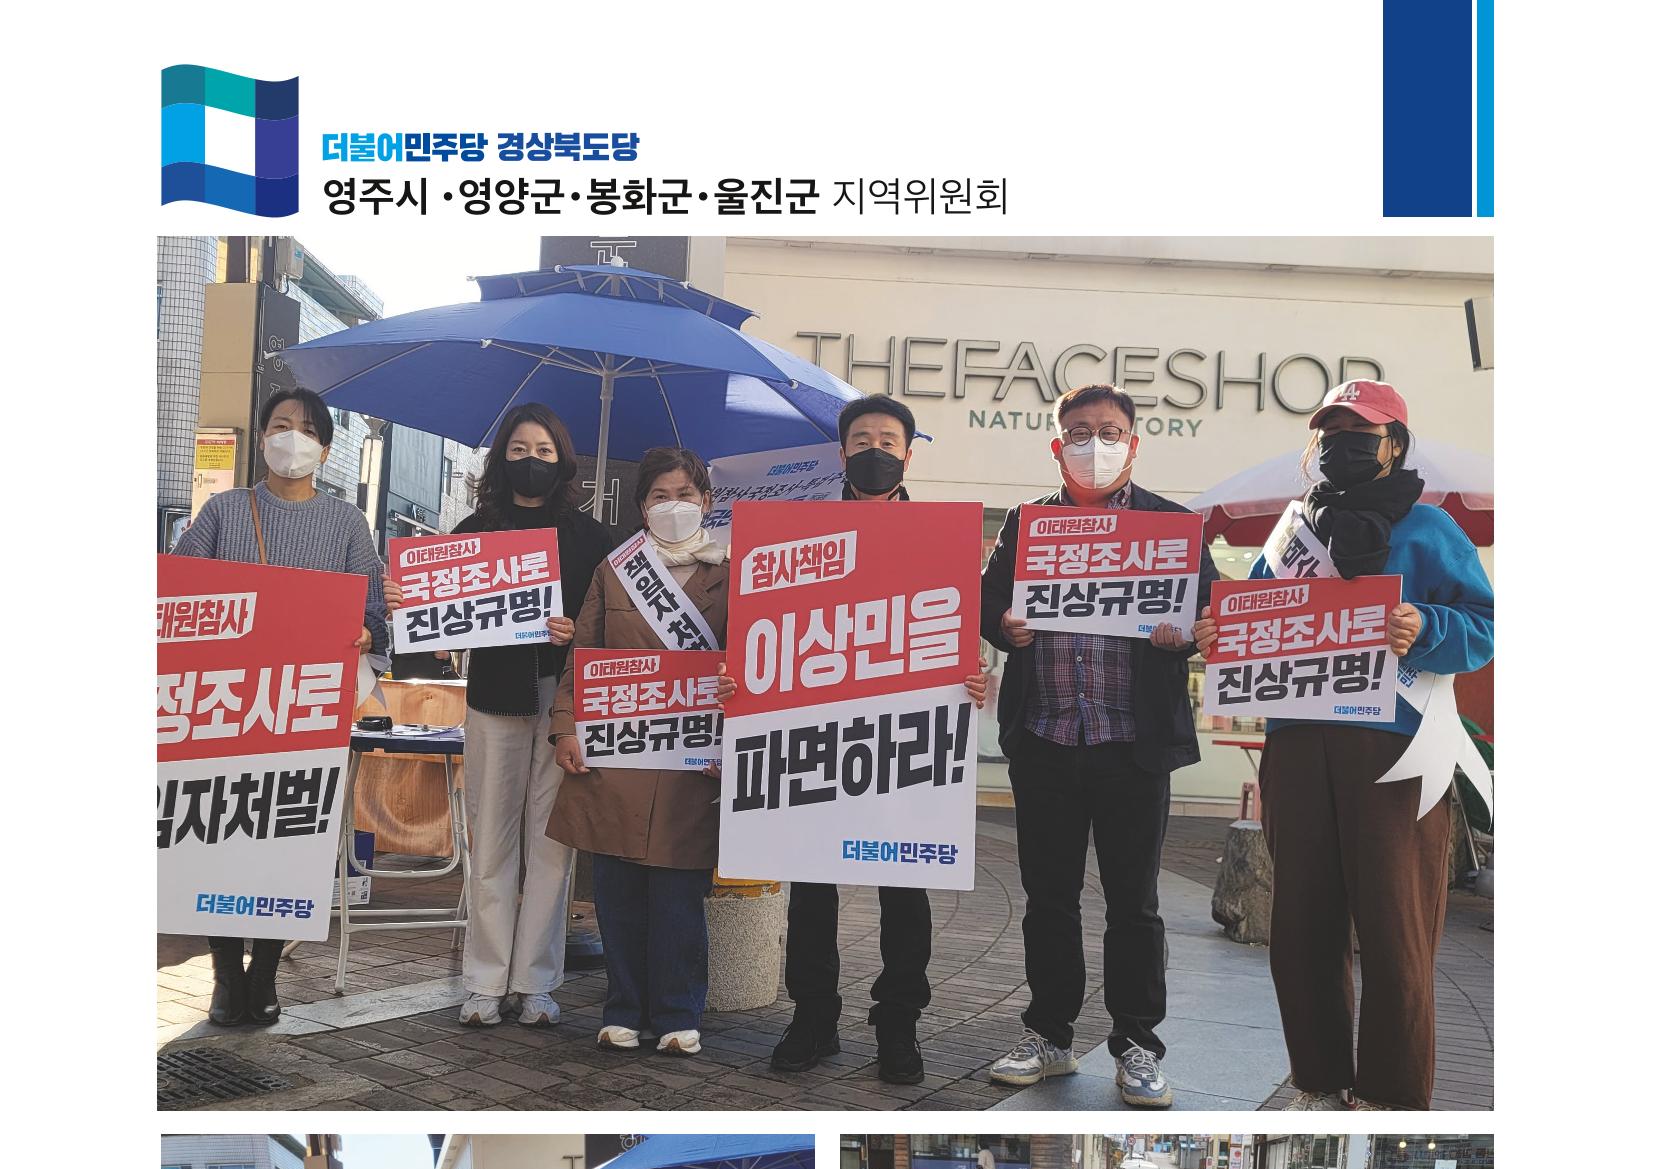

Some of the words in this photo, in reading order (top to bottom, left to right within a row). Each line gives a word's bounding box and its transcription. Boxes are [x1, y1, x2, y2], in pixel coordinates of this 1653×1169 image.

[1037, 517, 1113, 535] 이태원참사
[406, 541, 477, 564] 이태원참사
[751, 538, 846, 590] 참사책임
[1026, 539, 1189, 576] 국정조사로
[401, 551, 550, 601] 국정조사로
[623, 550, 680, 622] 책임자
[406, 586, 553, 644] 진상규명!
[1025, 578, 1188, 620] 진상규명!
[1228, 587, 1305, 613] 이태원참사
[515, 629, 551, 640] 더불어민주
[745, 586, 962, 695] 이상민을
[1218, 605, 1386, 657] 국정조사로
[590, 657, 656, 677] 이태원참사
[1218, 650, 1387, 705] 진상규명!
[583, 675, 719, 716] 국정조사로
[1333, 705, 1382, 716] 더불어민주당
[585, 712, 724, 758] 진상규명!
[732, 702, 972, 812] 파면하라!
[842, 840, 959, 864] 더불어민주당
[196, 893, 315, 919] 더불어민주당
